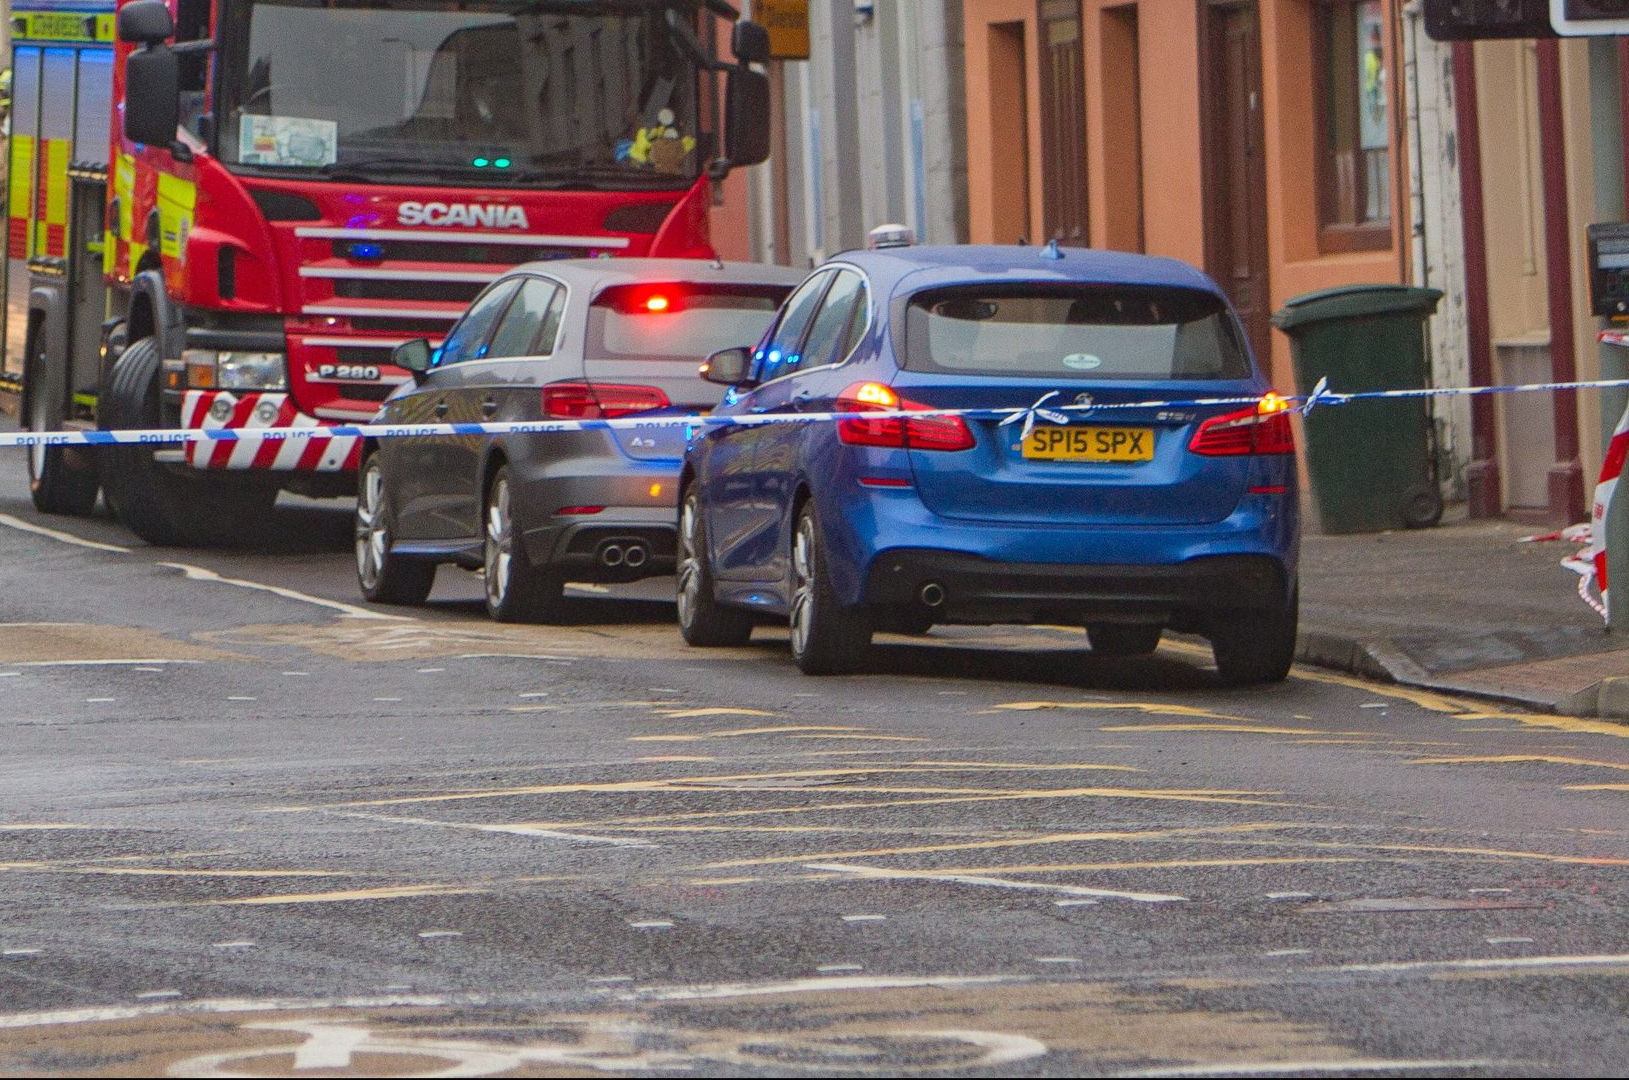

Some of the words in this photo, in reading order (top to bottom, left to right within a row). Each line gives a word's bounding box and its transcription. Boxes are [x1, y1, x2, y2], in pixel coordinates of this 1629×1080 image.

[397, 201, 529, 229] SCANIA
[319, 364, 335, 377] P
[336, 365, 379, 379] 280
[1032, 429, 1087, 453] SP15
[1096, 431, 1143, 454] SPX
